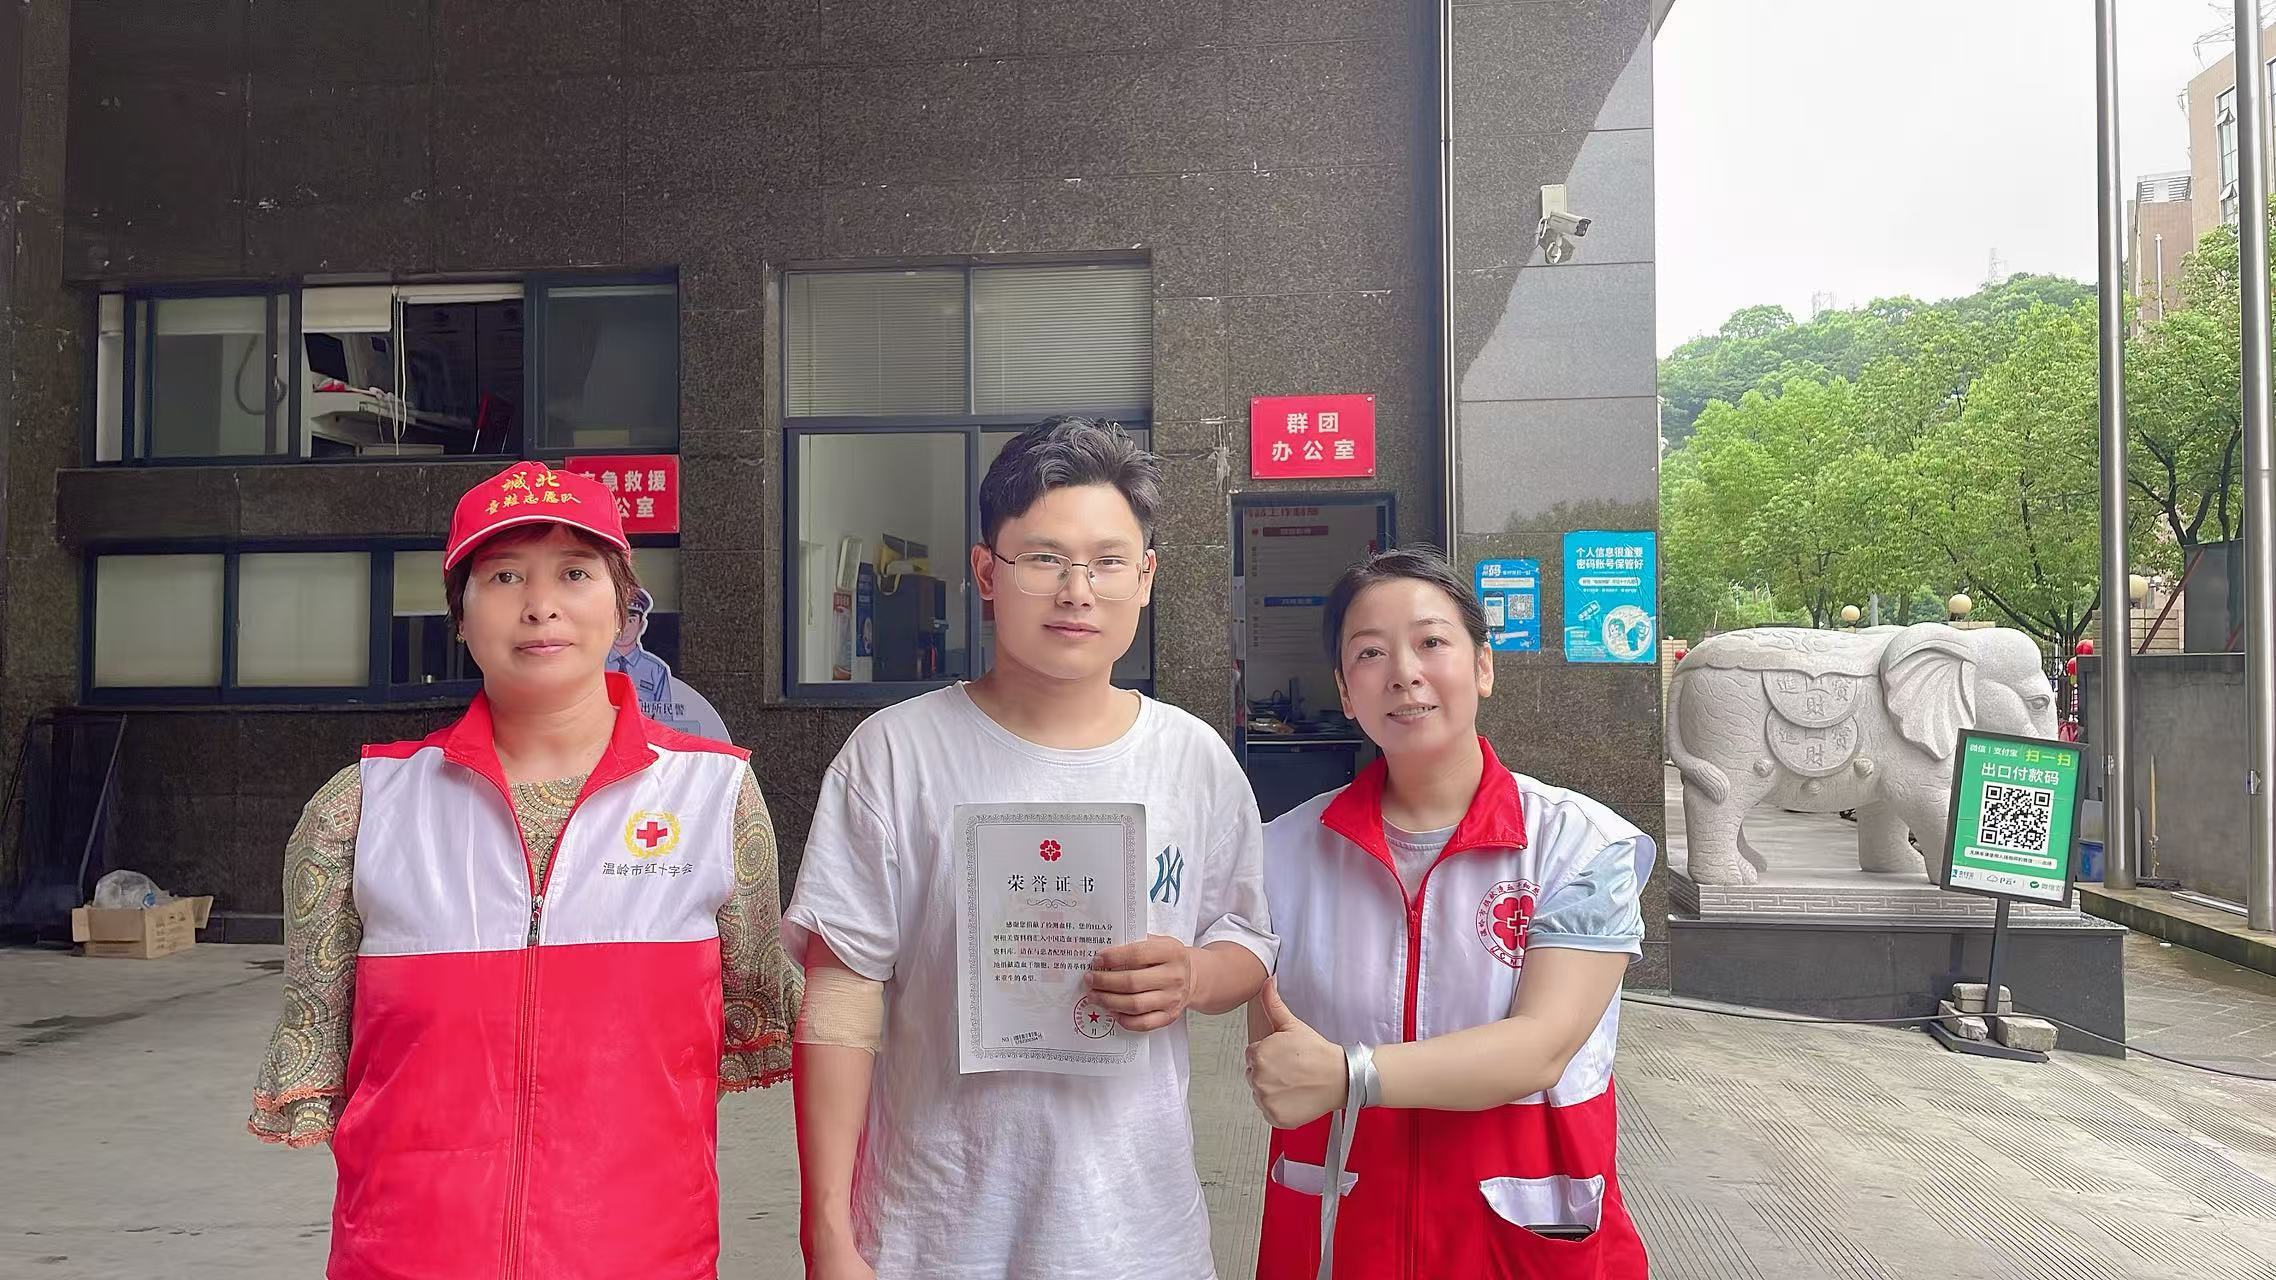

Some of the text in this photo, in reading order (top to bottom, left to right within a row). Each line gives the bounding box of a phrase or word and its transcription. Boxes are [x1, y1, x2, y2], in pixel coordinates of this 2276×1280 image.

[1287, 412, 1339, 434] 群团
[1271, 439, 1355, 462] 办公室
[501, 470, 561, 492] 城北
[615, 497, 655, 518] 公室
[1575, 546, 1644, 558] 个人信息很重要
[1575, 558, 1644, 570] 密码账号保管好
[640, 702, 685, 716] 出所民警
[1969, 744, 2072, 768] 微信 支付宝 扫一扫
[1981, 761, 2060, 786] 出口付款码
[602, 861, 694, 878] 温岭市红十字会
[1007, 874, 1096, 894] 荣誉证书
